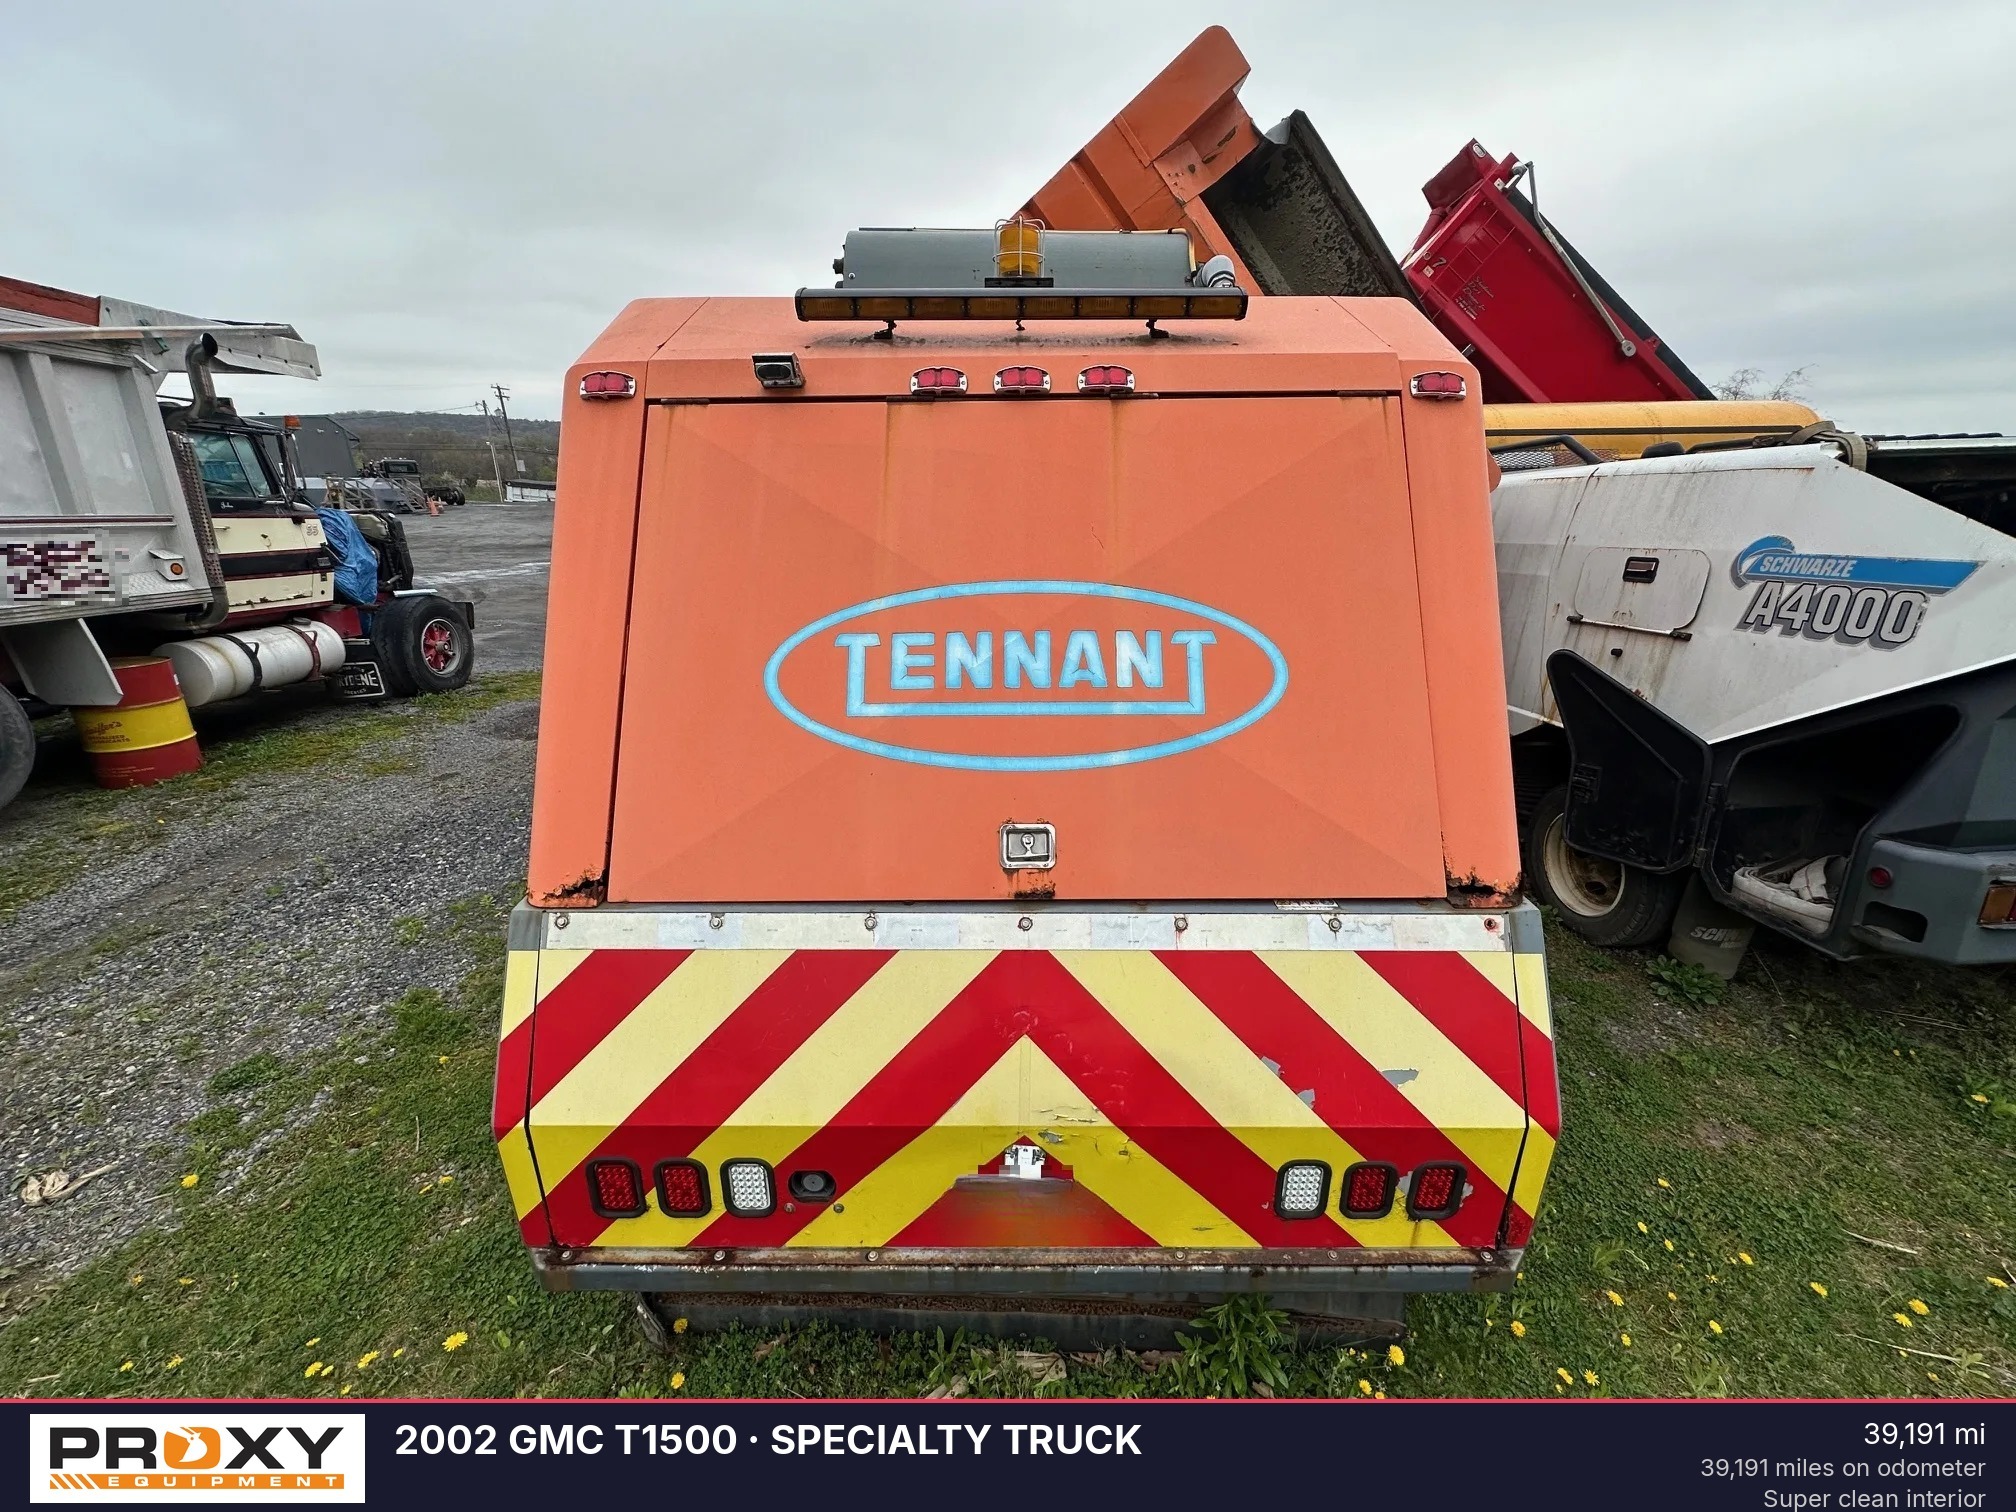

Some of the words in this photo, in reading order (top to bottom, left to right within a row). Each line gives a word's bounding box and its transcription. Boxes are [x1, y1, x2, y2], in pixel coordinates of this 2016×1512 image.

[1759, 555, 1857, 578] SCHWARZE
[1740, 579, 1930, 647] A4000
[834, 630, 1218, 717] TENNANT
